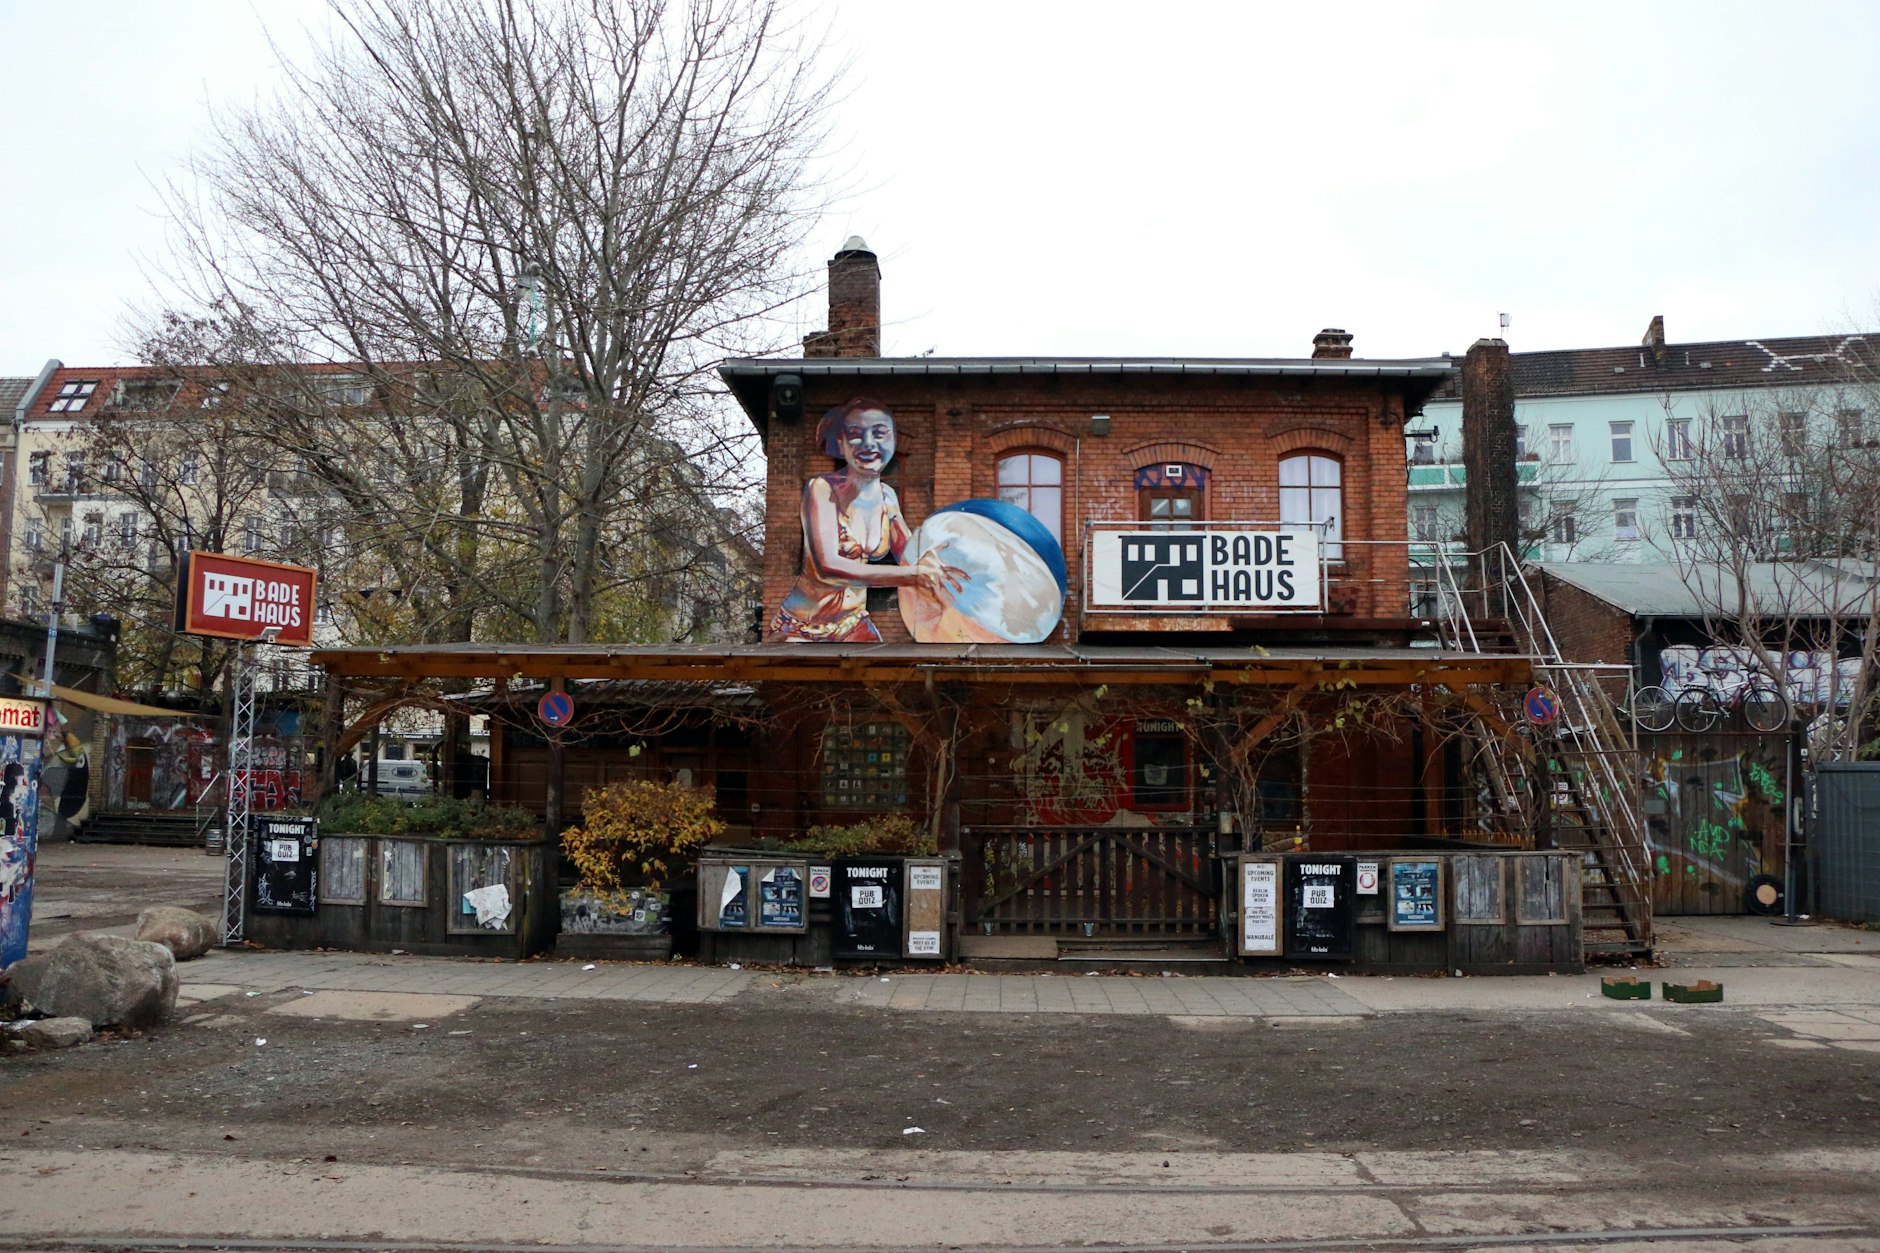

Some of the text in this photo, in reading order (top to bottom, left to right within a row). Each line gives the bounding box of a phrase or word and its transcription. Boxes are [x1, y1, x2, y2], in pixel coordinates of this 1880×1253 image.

[1211, 535, 1294, 565] BADE
[1211, 569, 1295, 601] HAUS
[255, 579, 300, 605] BADE
[254, 601, 301, 627] HAUS
[0, 705, 40, 727] mat
[269, 823, 305, 834] TONIGHT
[846, 867, 888, 878] TONIGHT
[1300, 864, 1341, 875] TONIGHT
[860, 890, 874, 898] PUB
[859, 897, 876, 905] QUIZ
[1310, 897, 1327, 905] QUIZ
